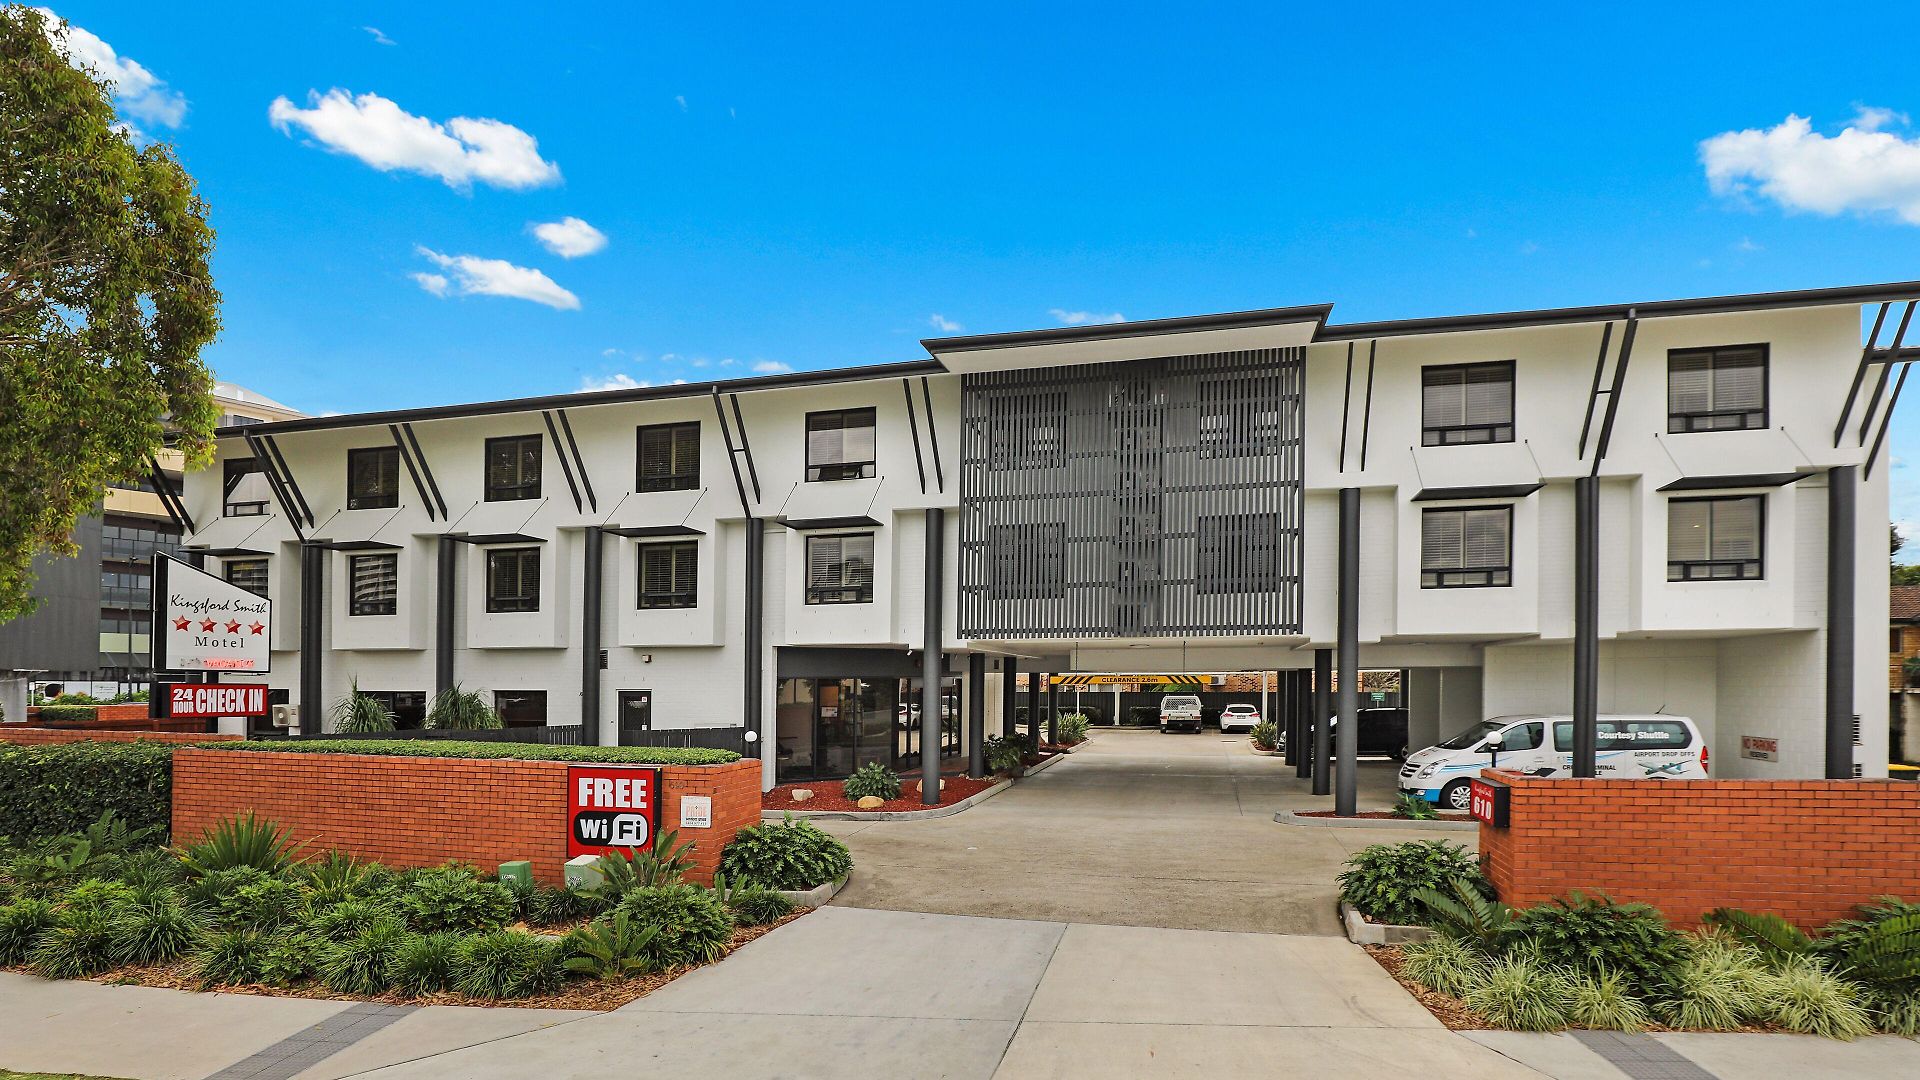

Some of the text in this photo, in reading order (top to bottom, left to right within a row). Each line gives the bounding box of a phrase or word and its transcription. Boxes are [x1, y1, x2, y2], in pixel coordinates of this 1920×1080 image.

[170, 593, 267, 614] Kingsford Smith
[194, 636, 245, 648] Motel
[173, 688, 193, 700] 24
[195, 688, 264, 714] CHECK IN
[172, 701, 194, 714] HOUR
[1598, 731, 1670, 741] Courtesy Shuttle
[578, 777, 647, 809] FREE
[1473, 796, 1492, 820] 610
